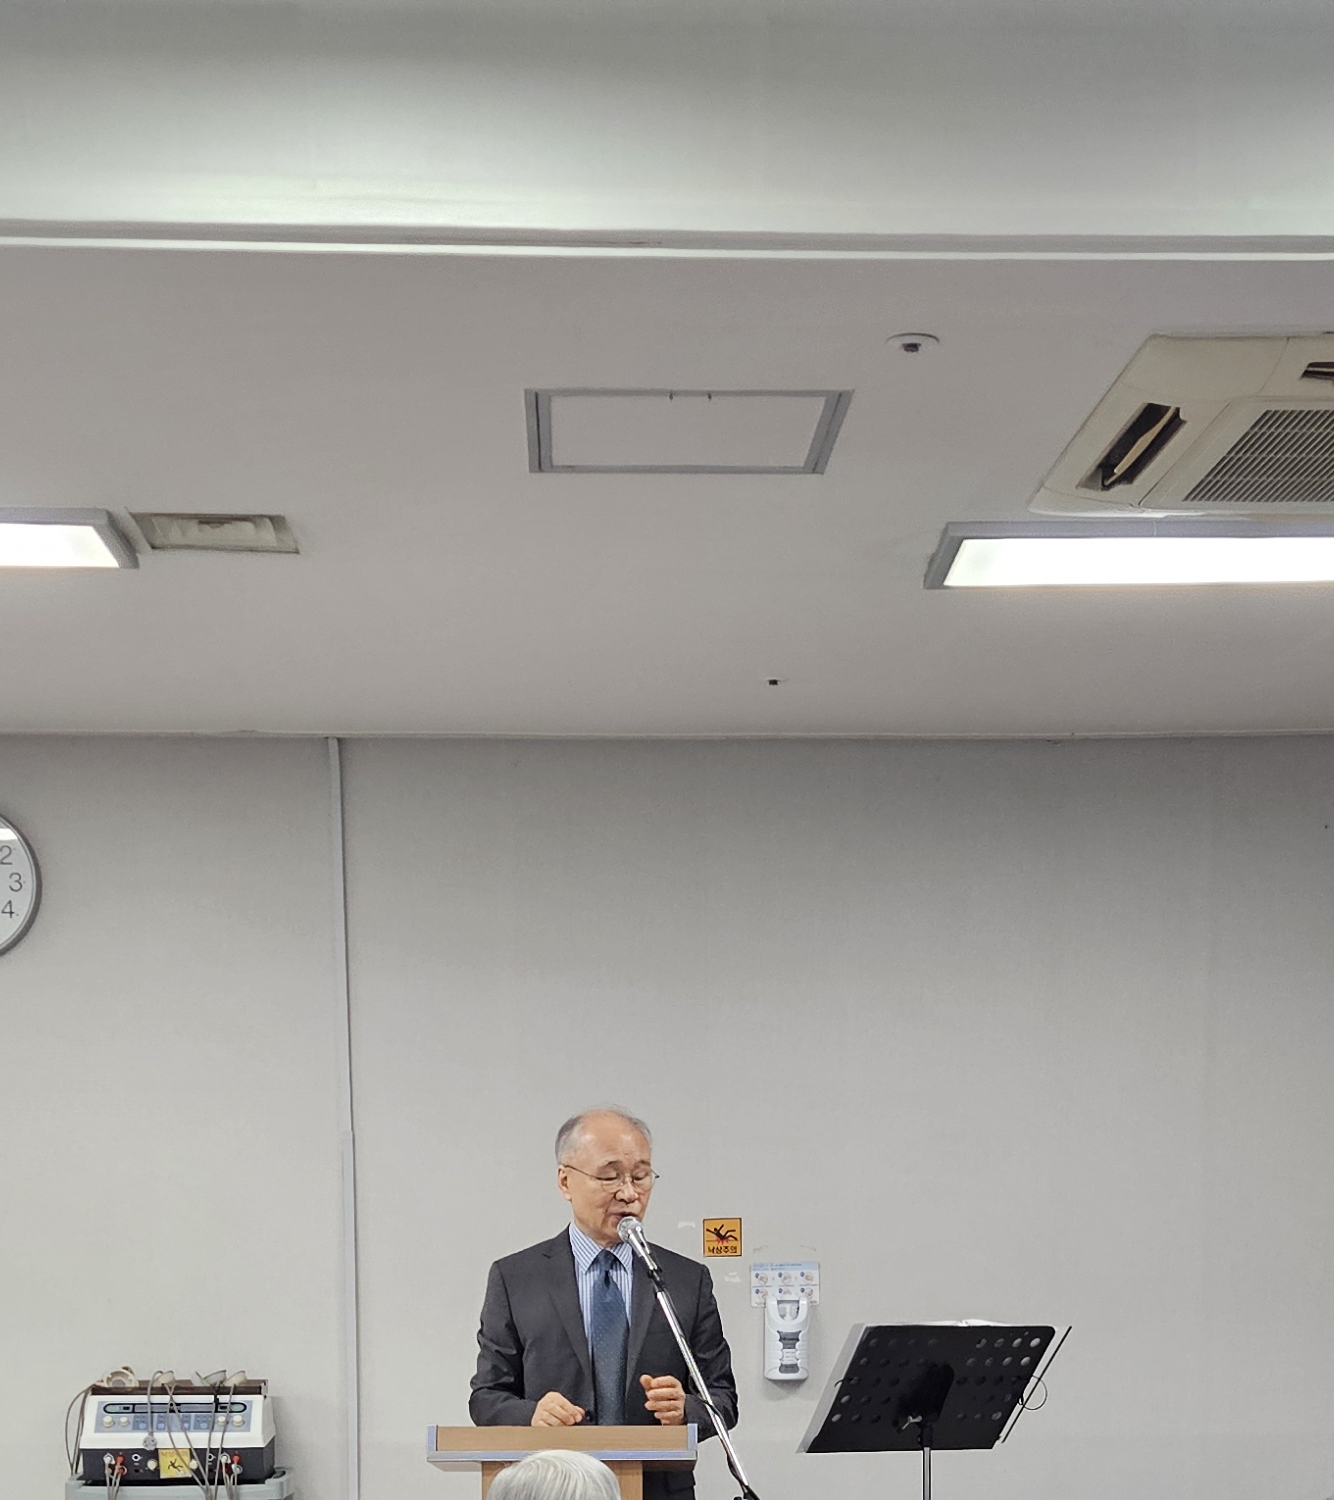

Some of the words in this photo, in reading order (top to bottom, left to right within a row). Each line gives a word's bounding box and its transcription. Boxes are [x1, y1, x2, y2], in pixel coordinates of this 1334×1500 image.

[0, 845, 13, 865] 2
[9, 872, 23, 892] 3
[1, 899, 15, 918] 4
[708, 1245, 738, 1255] 낙상주의
